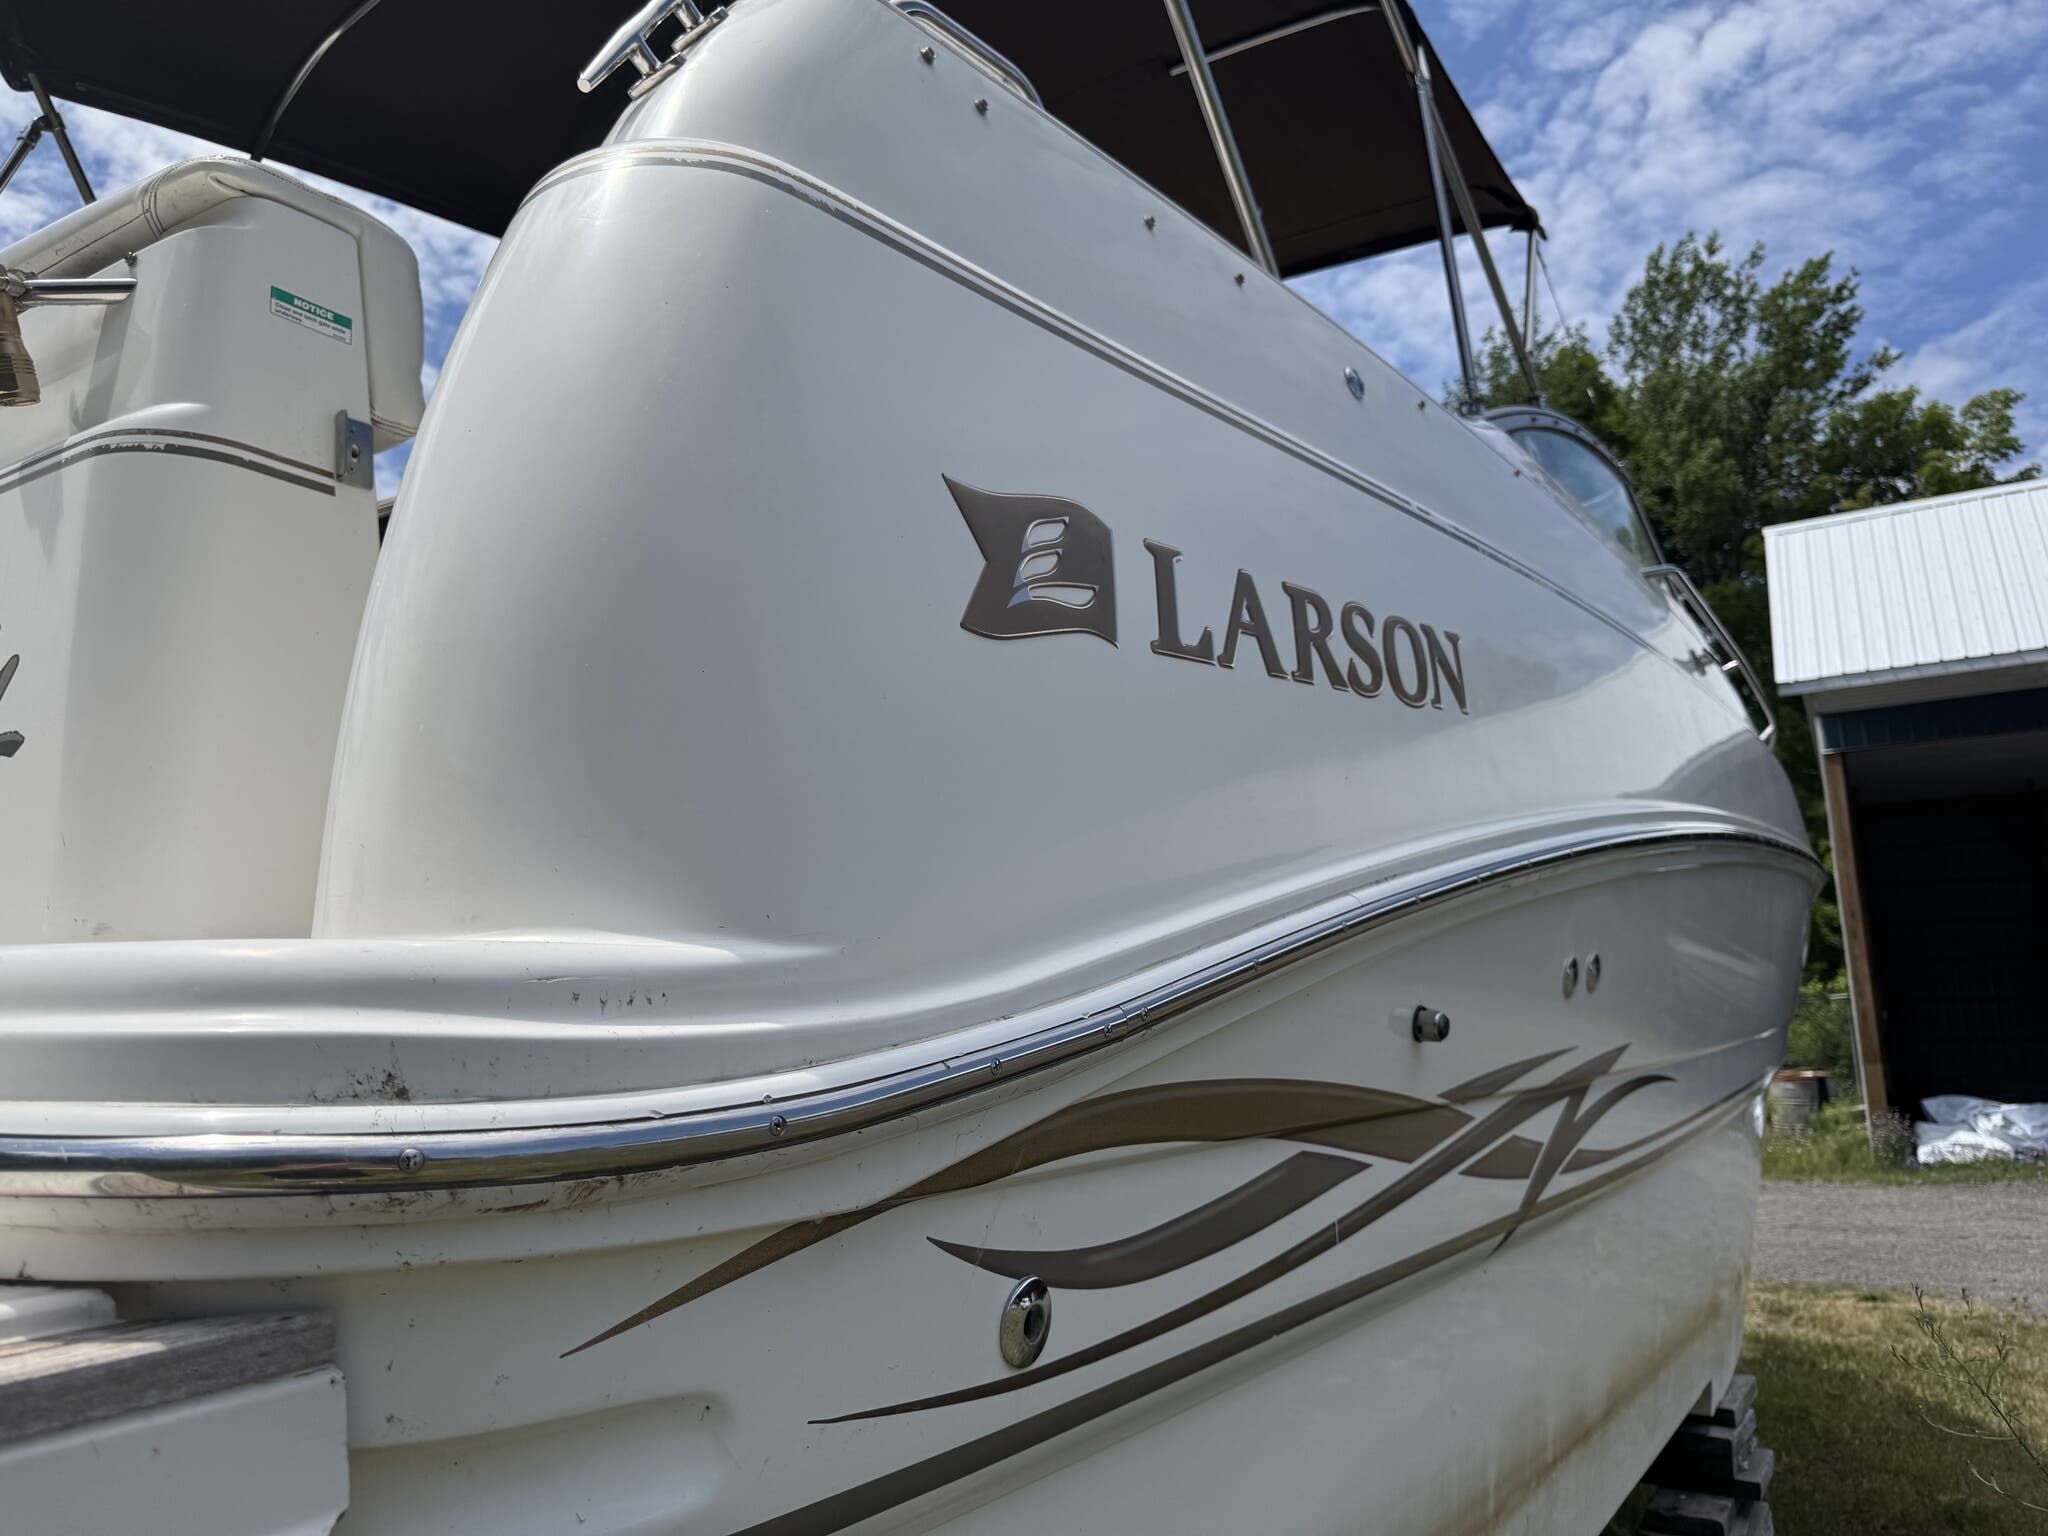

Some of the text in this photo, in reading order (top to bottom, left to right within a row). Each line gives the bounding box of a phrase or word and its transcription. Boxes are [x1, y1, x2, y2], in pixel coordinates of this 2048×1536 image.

[294, 298, 334, 321] NOTICE
[318, 319, 331, 329] gate
[1143, 537, 1469, 715] LARSON
